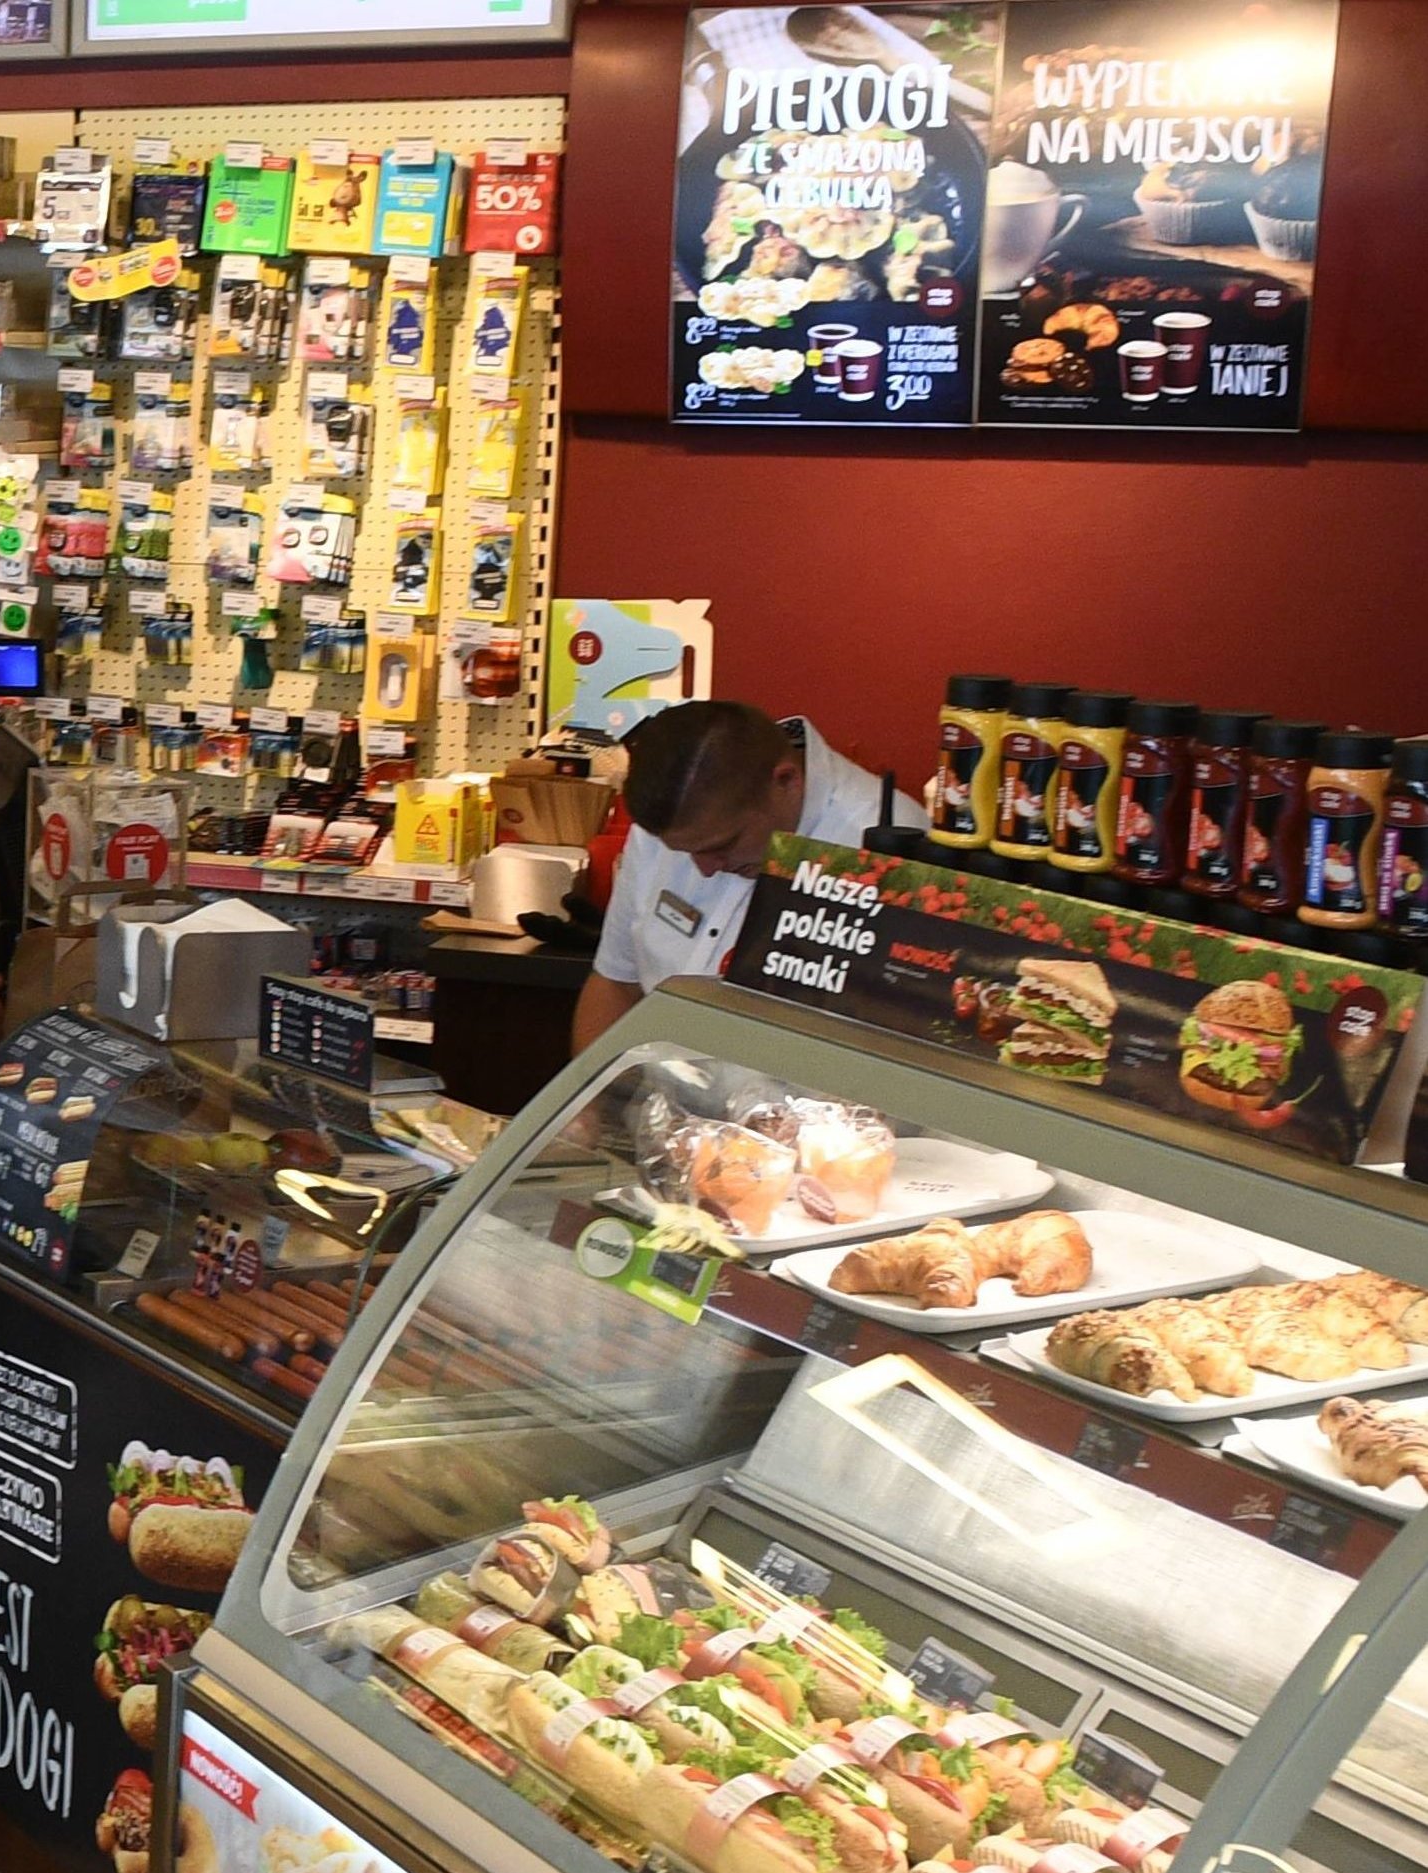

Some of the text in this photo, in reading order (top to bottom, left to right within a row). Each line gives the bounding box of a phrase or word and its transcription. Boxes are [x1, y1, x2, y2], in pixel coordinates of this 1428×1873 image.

[722, 62, 953, 134] PIEROGI
[1026, 116, 1292, 168] NA MIEJSCU
[474, 184, 543, 212] 50%
[1209, 361, 1290, 397] TANIEJ
[790, 859, 884, 917] Nasze,
[773, 907, 876, 955] polskie
[762, 950, 850, 994] smaki
[1339, 1018, 1372, 1038] cafe
[1344, 1004, 1377, 1024] stop
